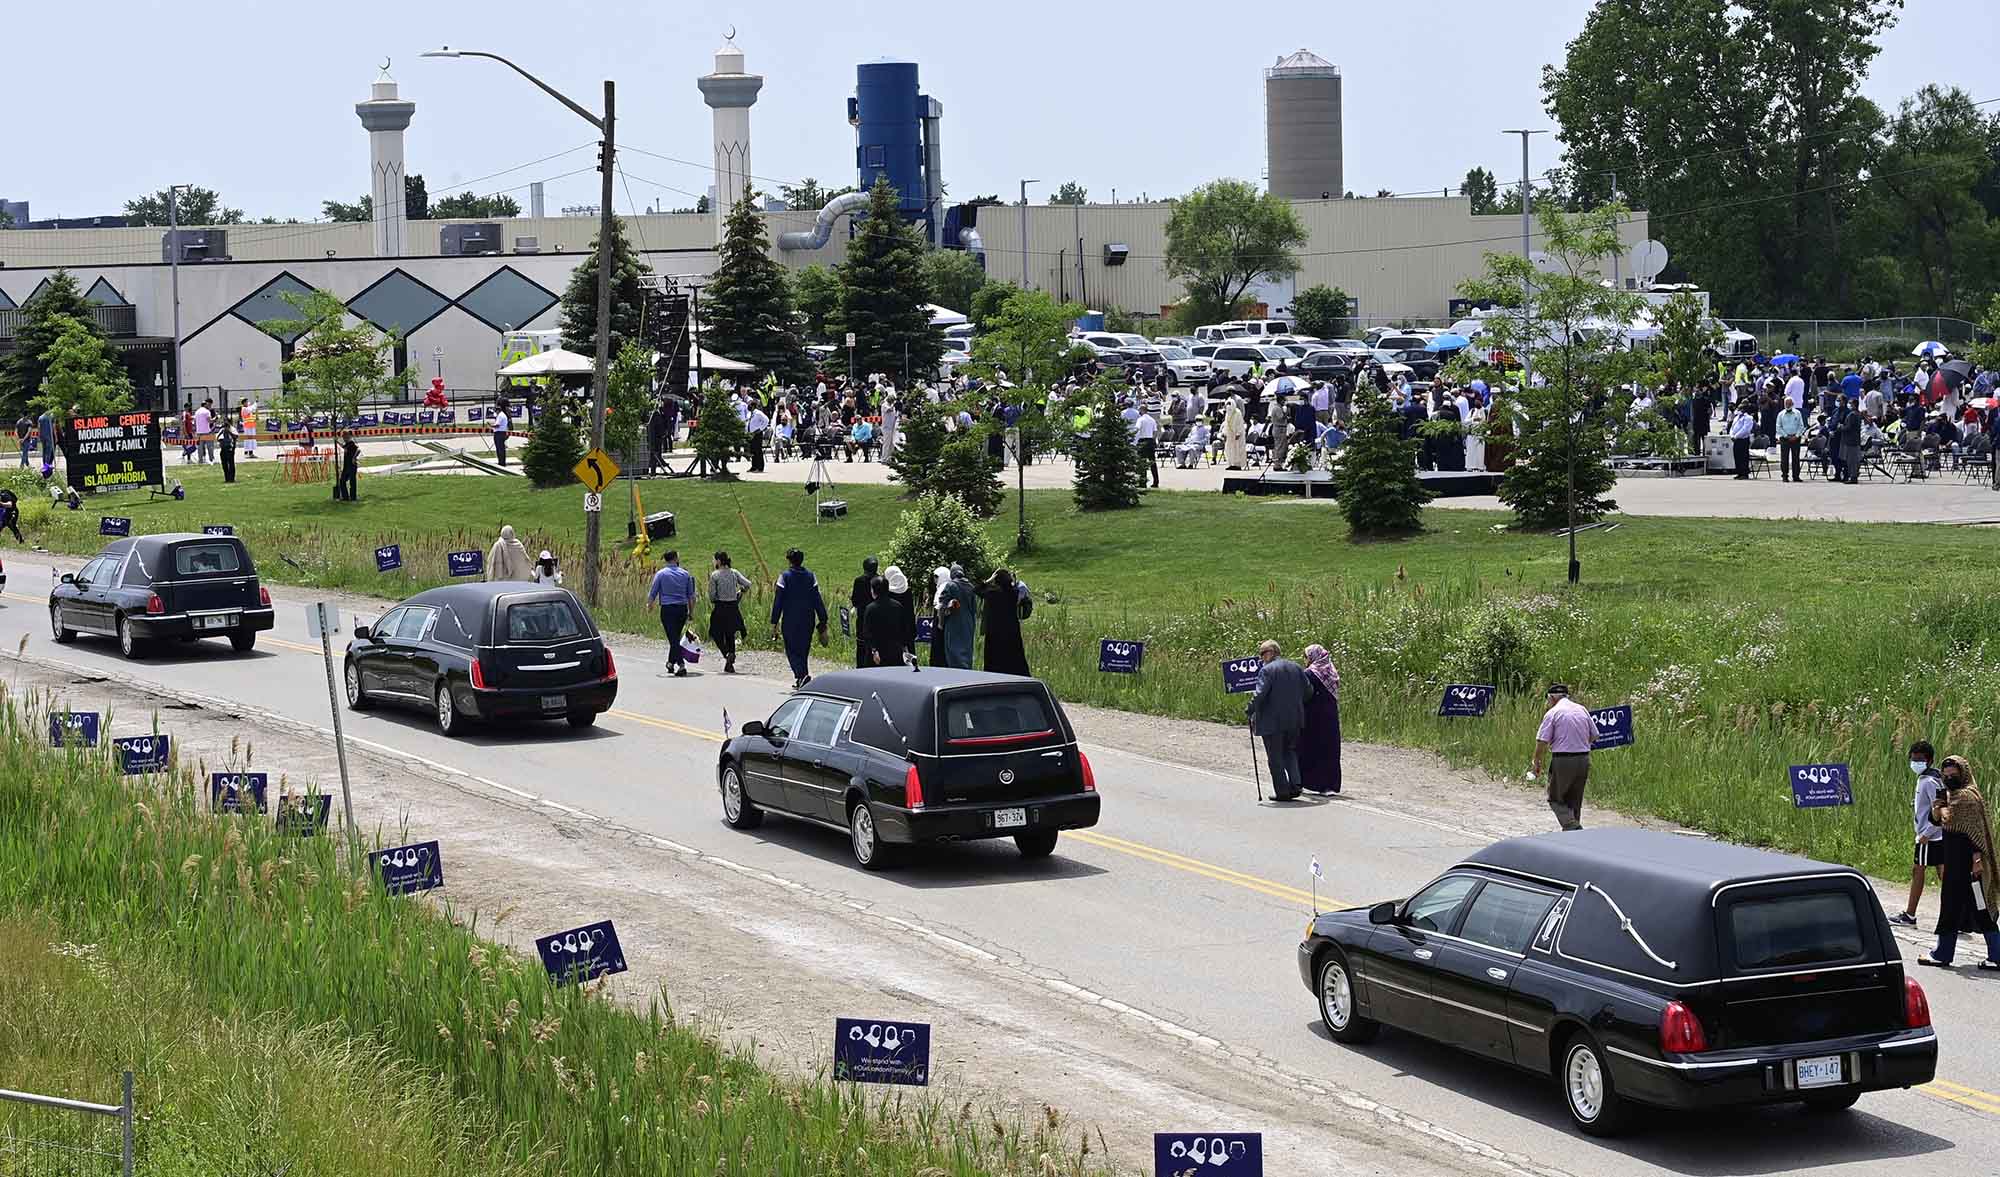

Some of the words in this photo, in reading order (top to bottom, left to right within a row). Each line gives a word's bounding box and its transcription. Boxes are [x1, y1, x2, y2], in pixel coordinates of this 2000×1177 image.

[74, 417, 109, 430] ISLAMIC
[119, 413, 151, 426] CENTRE
[78, 427, 124, 440] MOURNING
[132, 425, 148, 436] THE
[79, 441, 114, 454] AFZAAL
[116, 438, 148, 451] FAMILY
[96, 463, 109, 474] NO
[122, 461, 134, 472] TO
[84, 471, 147, 487] ISLAMOPHOBIA
